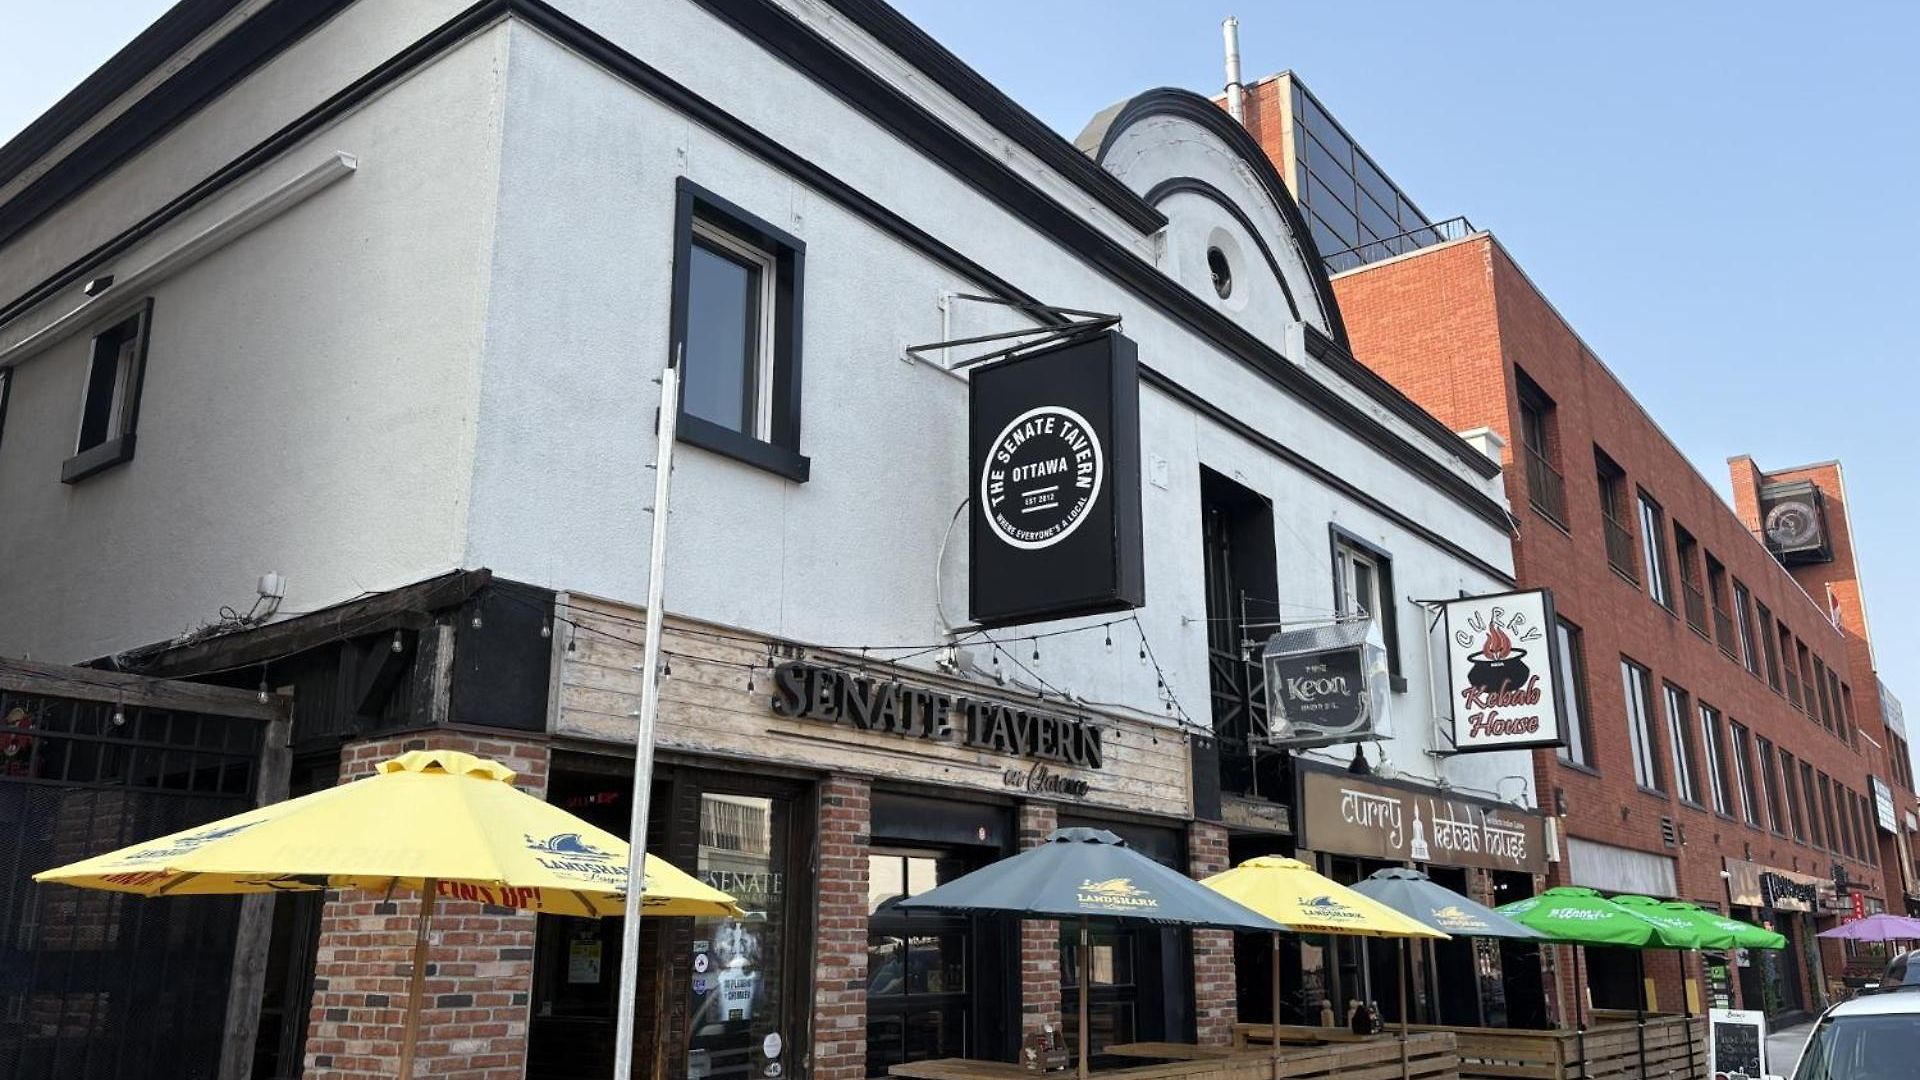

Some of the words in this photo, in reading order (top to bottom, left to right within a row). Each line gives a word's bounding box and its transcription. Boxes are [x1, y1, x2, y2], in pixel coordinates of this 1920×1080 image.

[997, 417, 1056, 464] SENATE
[1059, 421, 1093, 489] TAVERN
[1012, 457, 1068, 482] OTTAWA
[990, 470, 1005, 507] THE
[1025, 498, 1037, 506] EST
[996, 512, 1017, 536] WHERE
[1016, 523, 1061, 541] EVERYONE'S
[1062, 518, 1069, 529] A
[1067, 497, 1088, 522] LOCAL
[1455, 606, 1543, 649] CURRY
[1462, 674, 1541, 710] Kebab
[771, 660, 951, 742] SENATE
[957, 697, 1104, 769] TAVERN
[1468, 710, 1540, 738] House
[1027, 762, 1090, 797] Clarence
[1341, 789, 1404, 849] curry
[1430, 800, 1480, 854] kebab
[1480, 809, 1527, 865] house
[536, 857, 650, 877] LANDSHAR
[709, 870, 783, 894] SENATE
[1076, 893, 1159, 907] LANDSHARK
